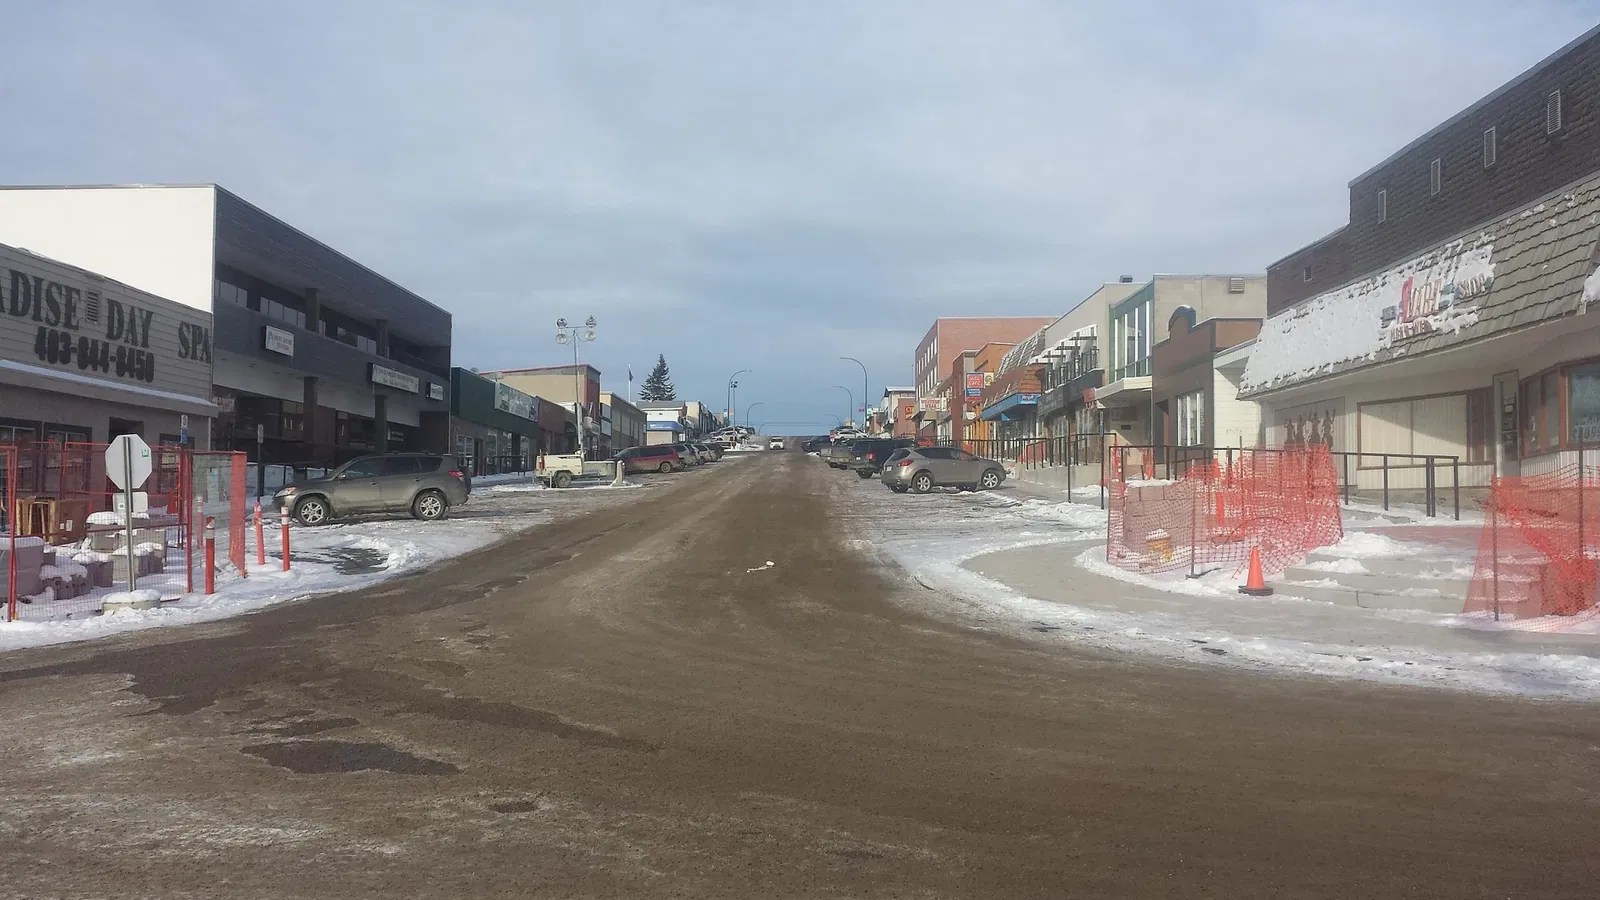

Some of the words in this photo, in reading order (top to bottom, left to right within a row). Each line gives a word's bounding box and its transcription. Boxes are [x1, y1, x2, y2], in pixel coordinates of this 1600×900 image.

[34, 326, 155, 384] 403-844-8450
[105, 298, 154, 348] DAY
[177, 320, 211, 364] SPA
